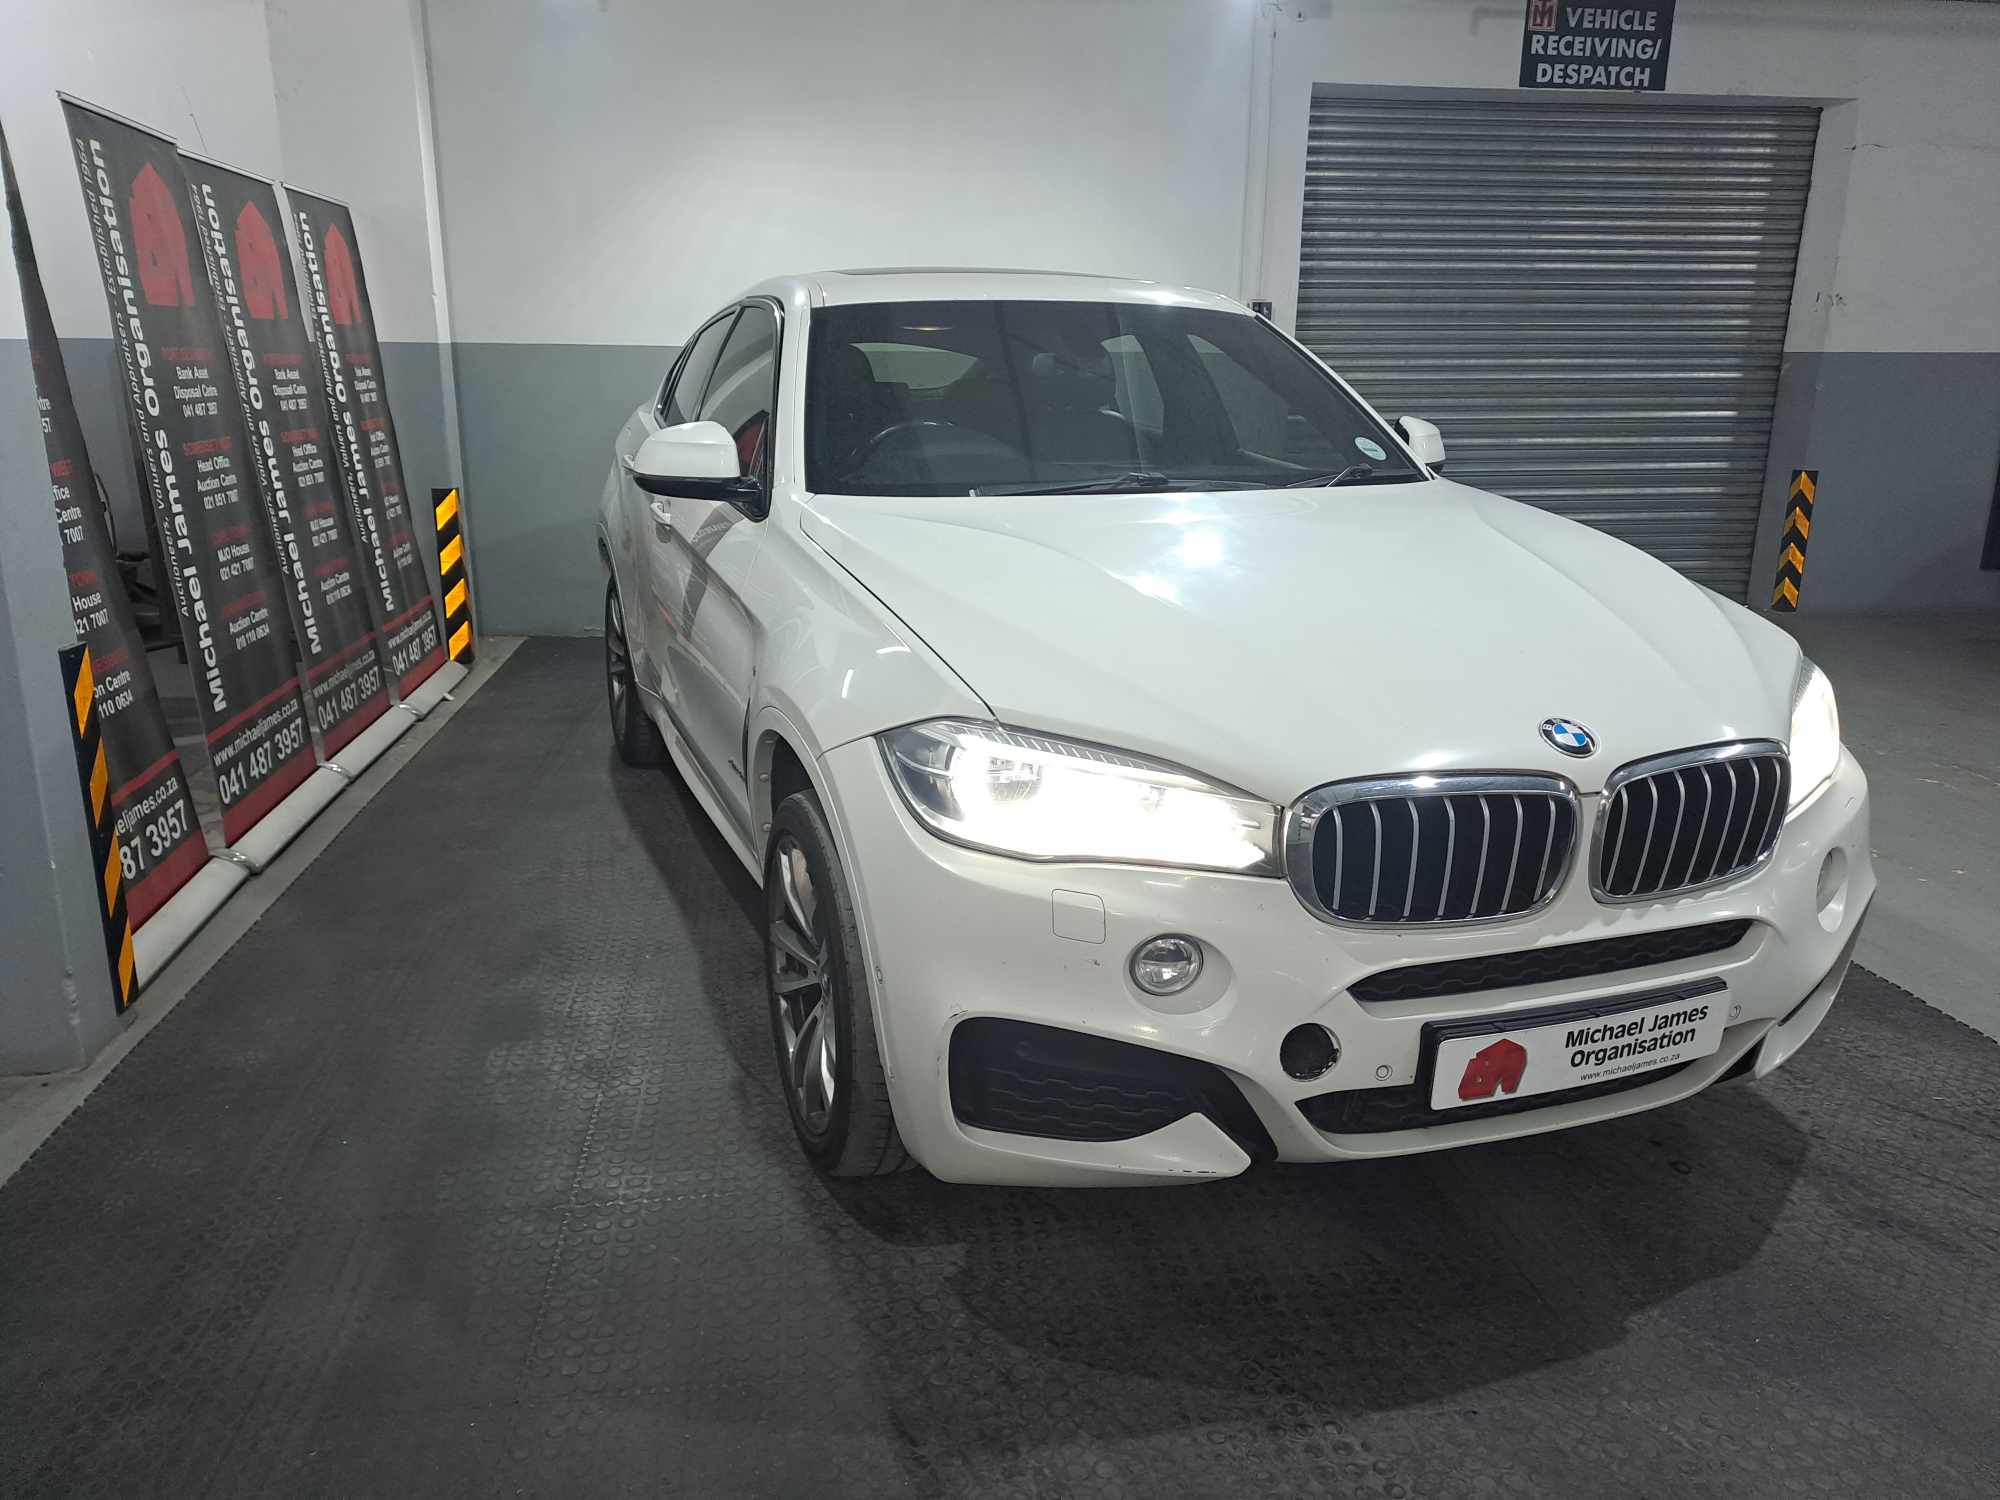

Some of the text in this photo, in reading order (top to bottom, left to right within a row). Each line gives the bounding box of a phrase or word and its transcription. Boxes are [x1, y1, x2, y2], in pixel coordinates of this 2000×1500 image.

[1530, 34, 1663, 60] RECEIVING/
[1566, 7, 1658, 31] VEHICLE
[1535, 63, 1651, 87] DESPATCH
[200, 184, 264, 409] Organisation
[299, 212, 347, 401] Organisation
[76, 137, 189, 616] Auctioneers, Valuers and Appraisers Established 1964
[225, 325, 247, 400] Appraisers
[88, 138, 226, 710] Michael James Organisation
[336, 425, 349, 467] Valuers
[253, 440, 267, 485] Valuers
[258, 421, 290, 524] James
[344, 412, 368, 499] James
[364, 508, 393, 610] Michael
[72, 592, 102, 612] House
[90, 608, 110, 629] 7007
[283, 533, 321, 652] Michael
[106, 669, 132, 692] Centre
[392, 647, 409, 677] 041
[318, 666, 380, 730] 041 487 3957
[218, 717, 304, 805] 041 487 3957
[115, 775, 179, 837] eljames.co.za
[119, 799, 189, 880] 87 3957
[1564, 1005, 1709, 1049] Michael James
[1570, 1028, 1697, 1068] Organisation
[1580, 1053, 1681, 1081] www.michaeljames.co.za
